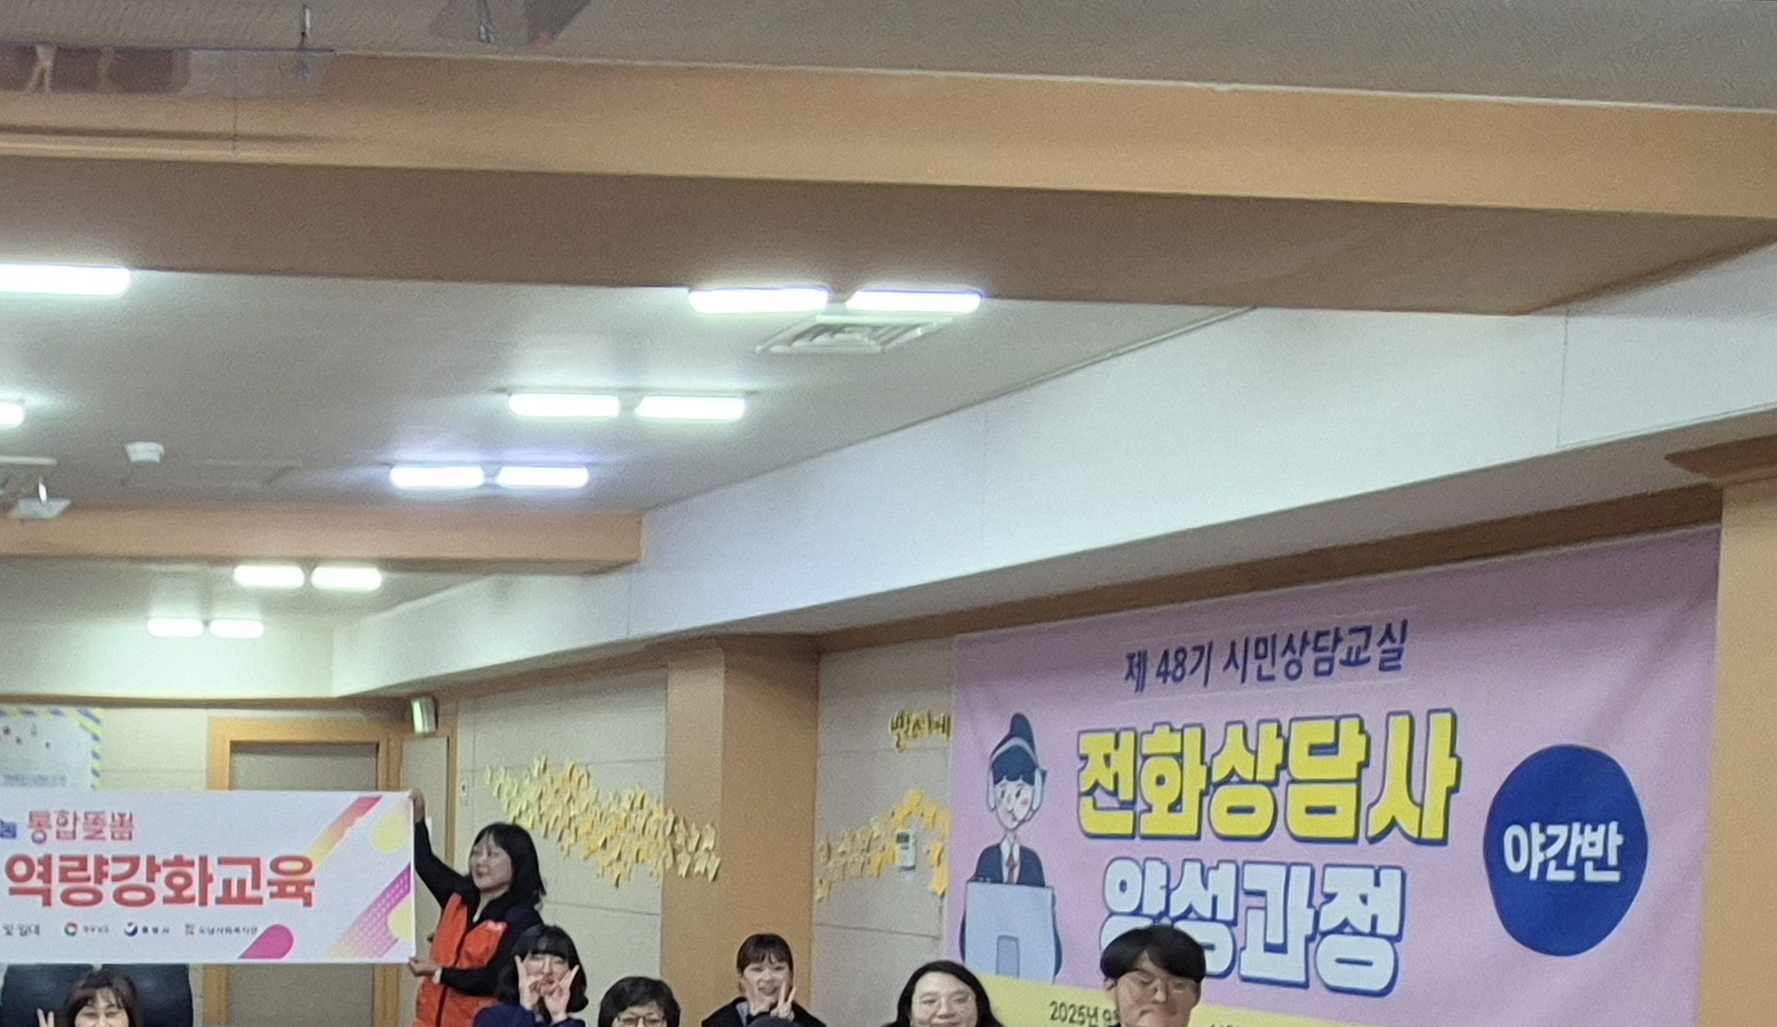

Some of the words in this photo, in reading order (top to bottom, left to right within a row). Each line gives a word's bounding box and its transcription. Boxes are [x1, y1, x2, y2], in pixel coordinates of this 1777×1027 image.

[1125, 649, 1148, 693] 제
[1155, 640, 1214, 687] 48기
[1222, 618, 1409, 684] 시민상담교실
[1077, 706, 1461, 845] 전화상담사
[3, 851, 317, 908] 역량강화교육
[1503, 819, 1623, 883] 야간반
[1099, 856, 1408, 998] 양성과정
